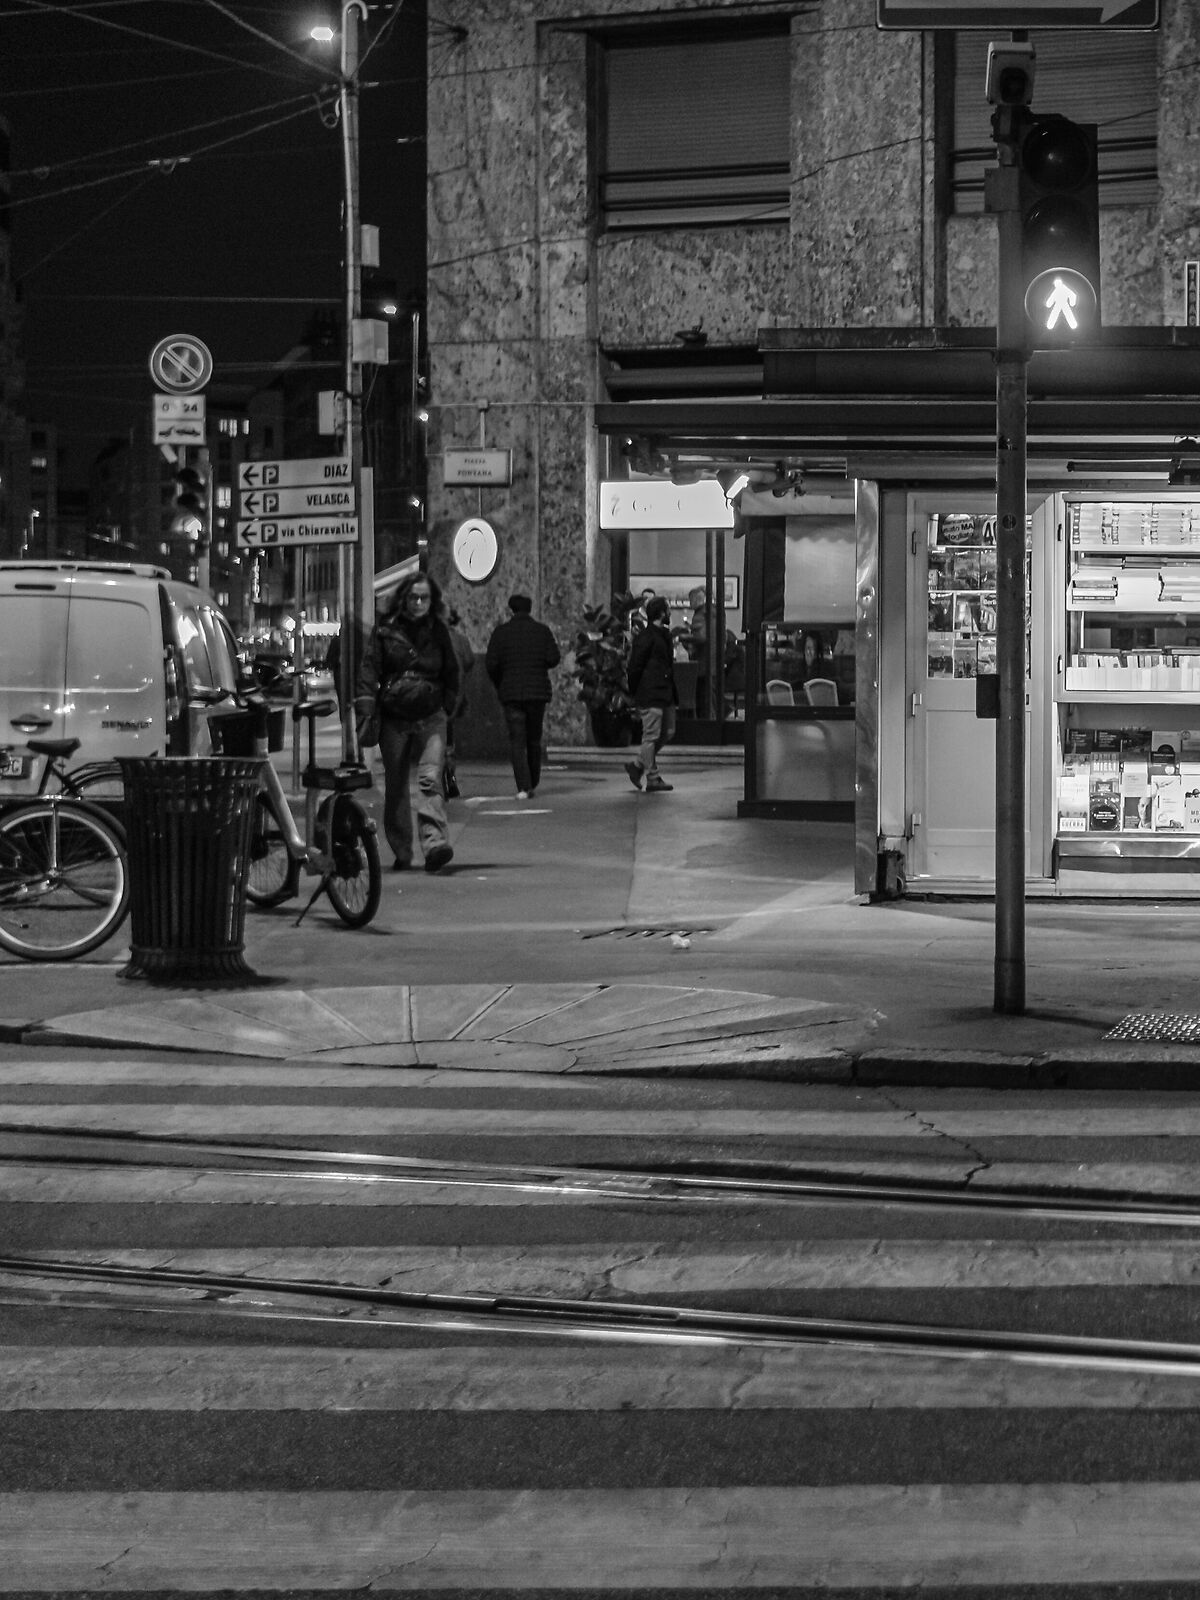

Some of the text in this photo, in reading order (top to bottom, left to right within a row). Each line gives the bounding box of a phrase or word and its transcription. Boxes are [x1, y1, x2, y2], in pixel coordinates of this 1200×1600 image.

[324, 463, 348, 478] DIAZ
[306, 493, 350, 506] VELASCA
[281, 527, 295, 537] via
[298, 522, 355, 536] Chiaravalle
